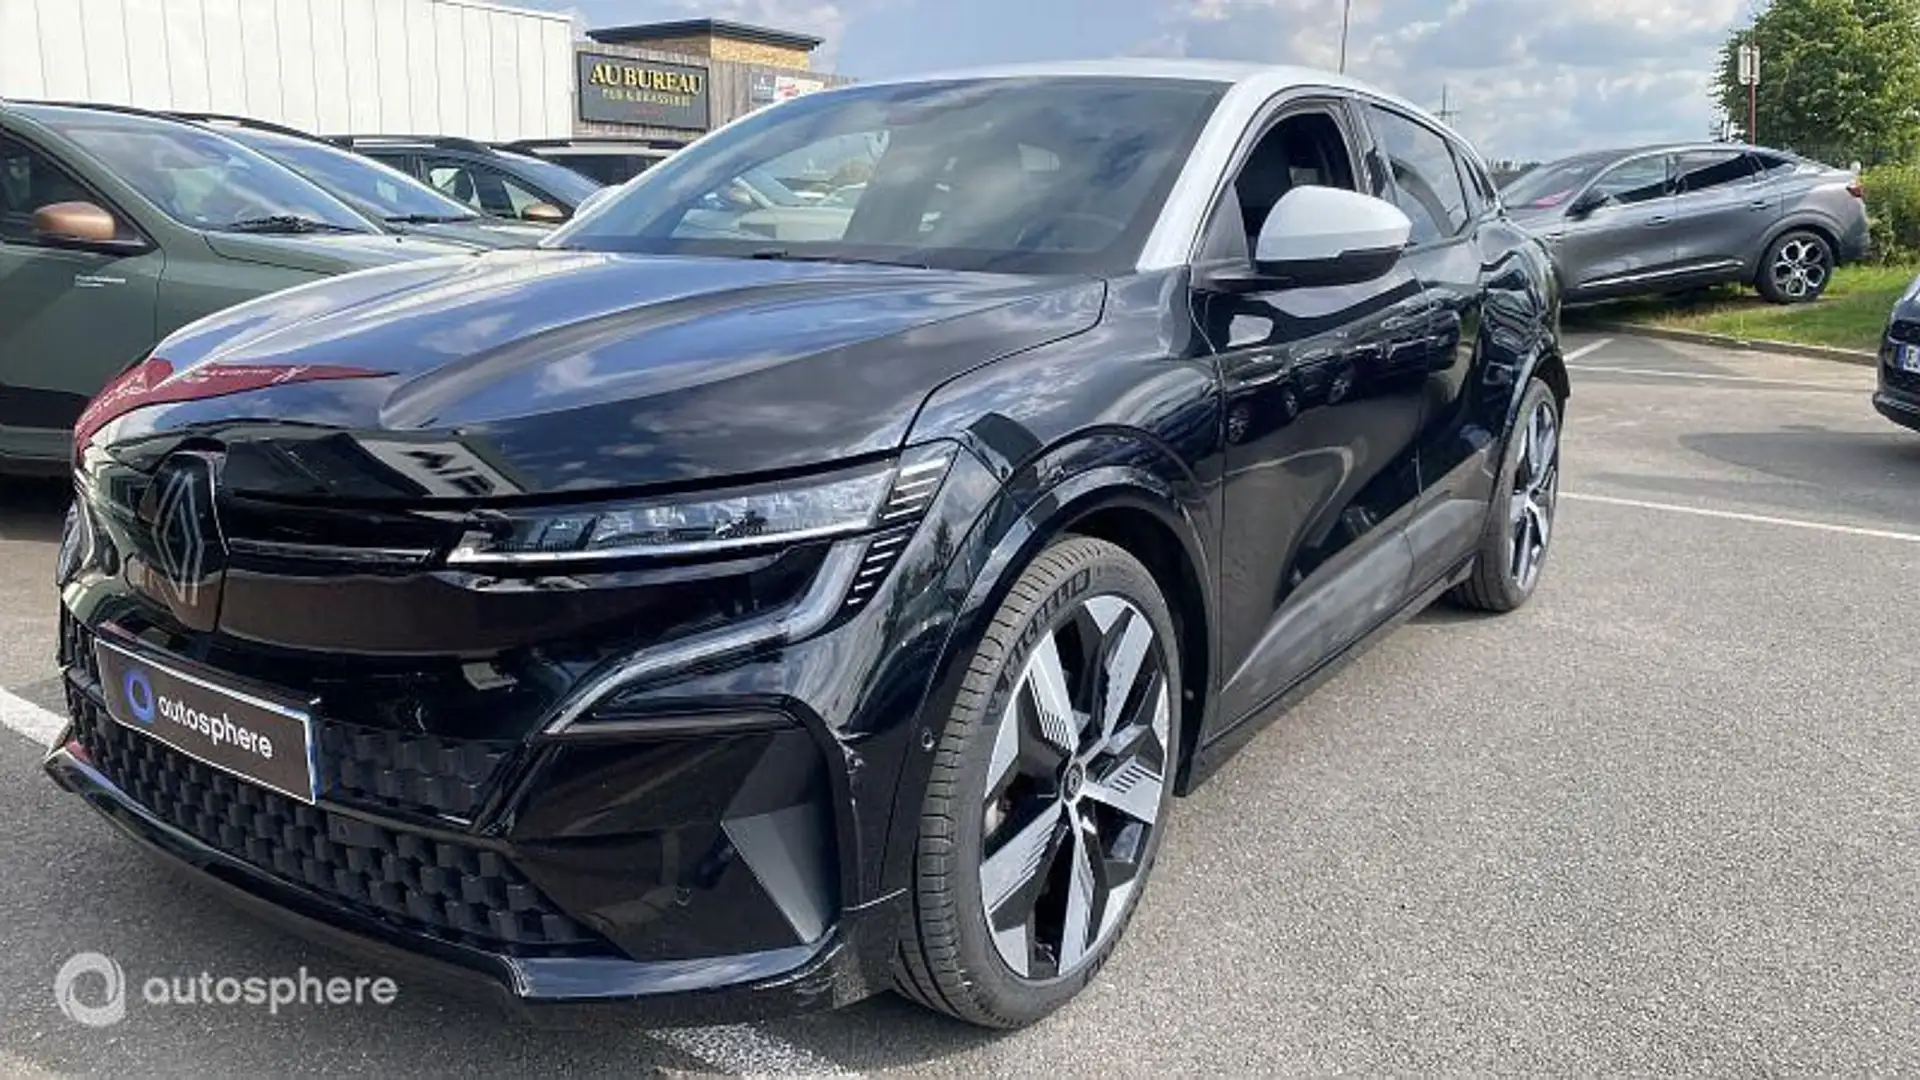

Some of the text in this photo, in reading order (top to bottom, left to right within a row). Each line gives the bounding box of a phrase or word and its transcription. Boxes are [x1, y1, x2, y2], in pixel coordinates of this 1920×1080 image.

[590, 62, 702, 95] AU BUREAU
[157, 694, 273, 760] autosphere
